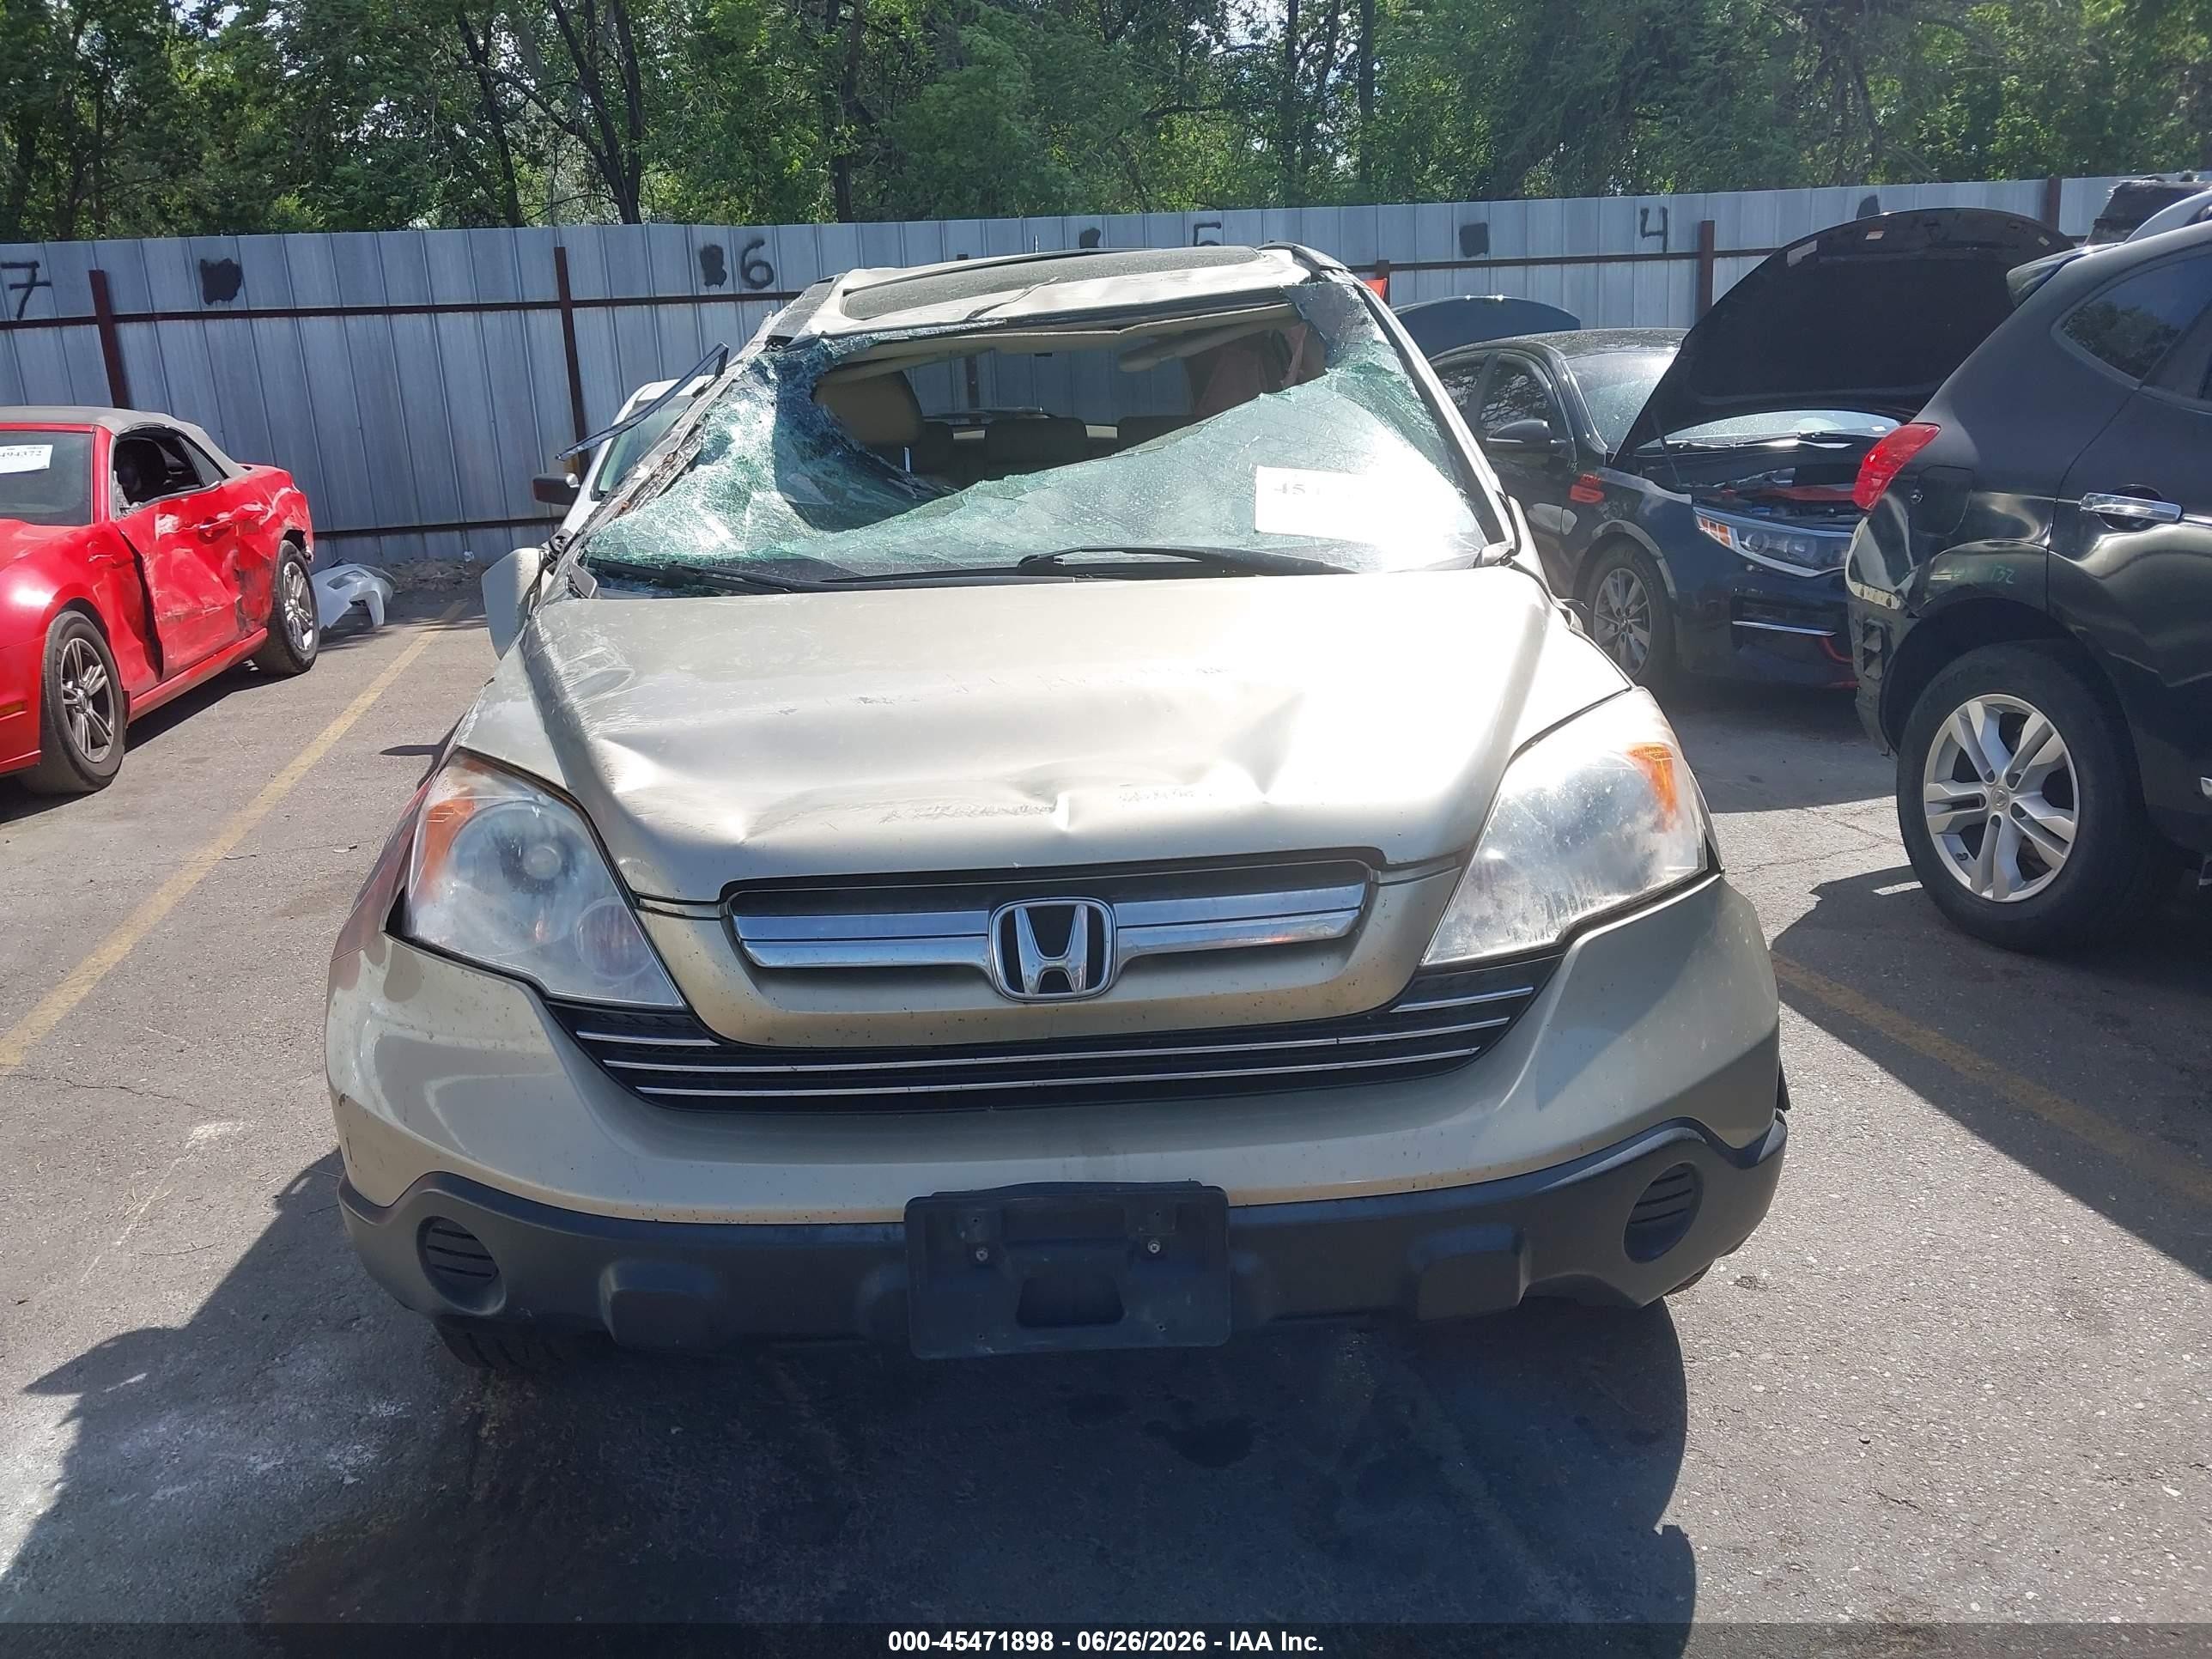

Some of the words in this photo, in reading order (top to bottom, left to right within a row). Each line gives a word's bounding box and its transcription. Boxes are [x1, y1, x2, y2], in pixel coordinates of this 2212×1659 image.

[1640, 206, 1668, 254] 4
[740, 238, 775, 289] 6
[0, 260, 52, 320] 7
